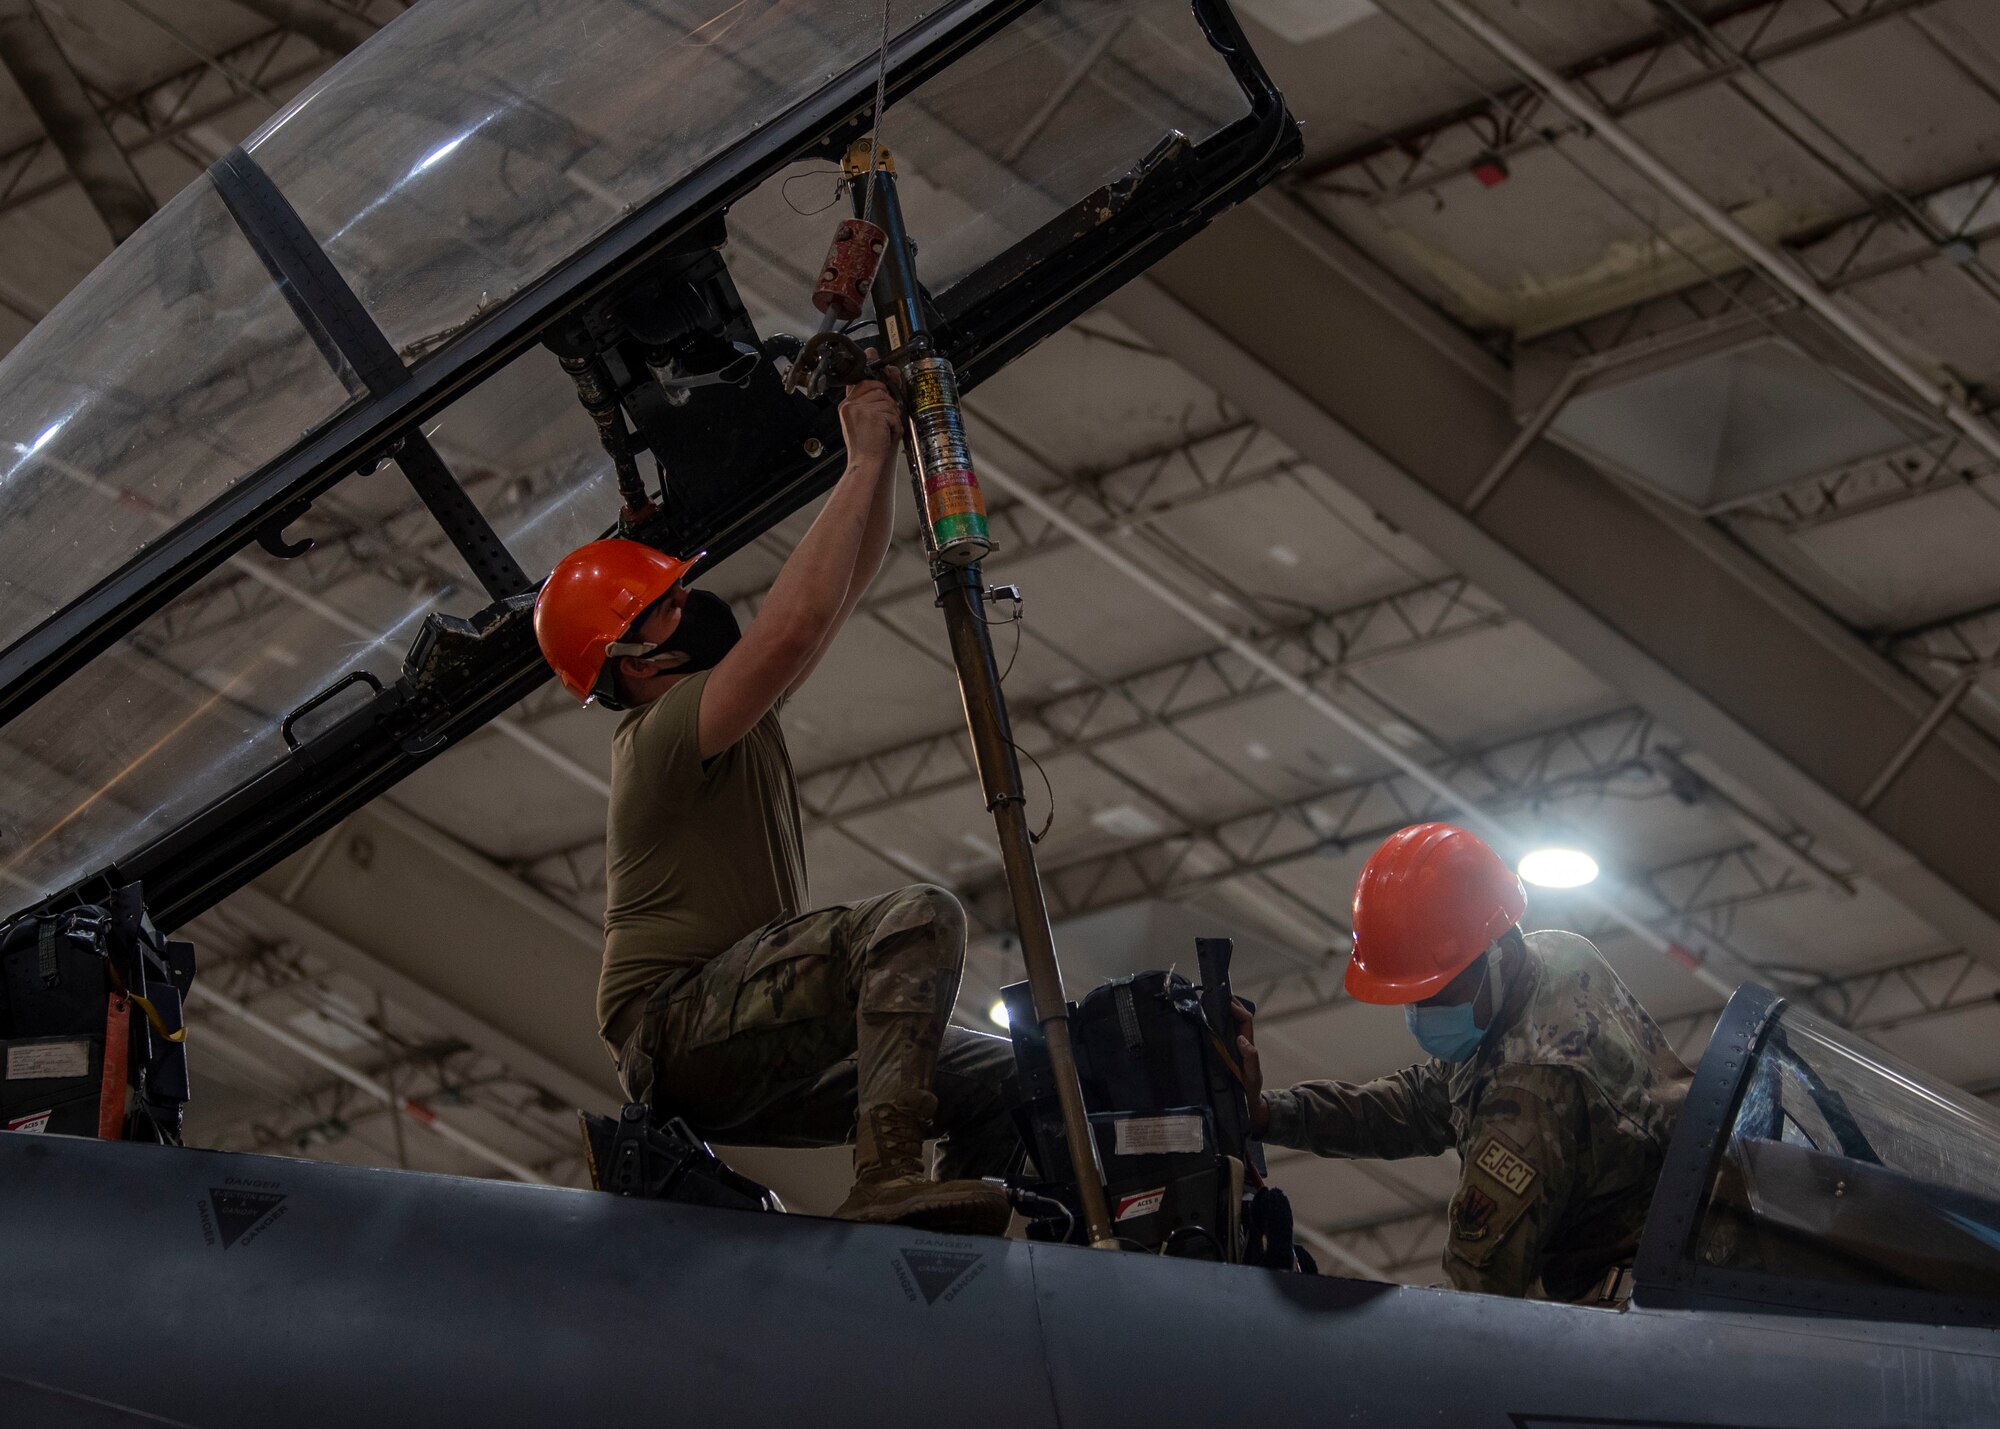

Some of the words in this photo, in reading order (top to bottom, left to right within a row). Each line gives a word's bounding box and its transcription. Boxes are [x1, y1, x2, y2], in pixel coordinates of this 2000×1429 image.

[23, 1121, 39, 1130] ACES
[224, 1177, 281, 1189] DANGER
[1480, 1144, 1531, 1190] EJECT
[197, 1199, 216, 1247] DANGER
[1137, 1199, 1153, 1208] ACES
[240, 1206, 289, 1246] DANGER
[914, 1239, 973, 1249] DANGER
[890, 1258, 917, 1303] DANGER
[944, 1262, 987, 1303] DANGER
